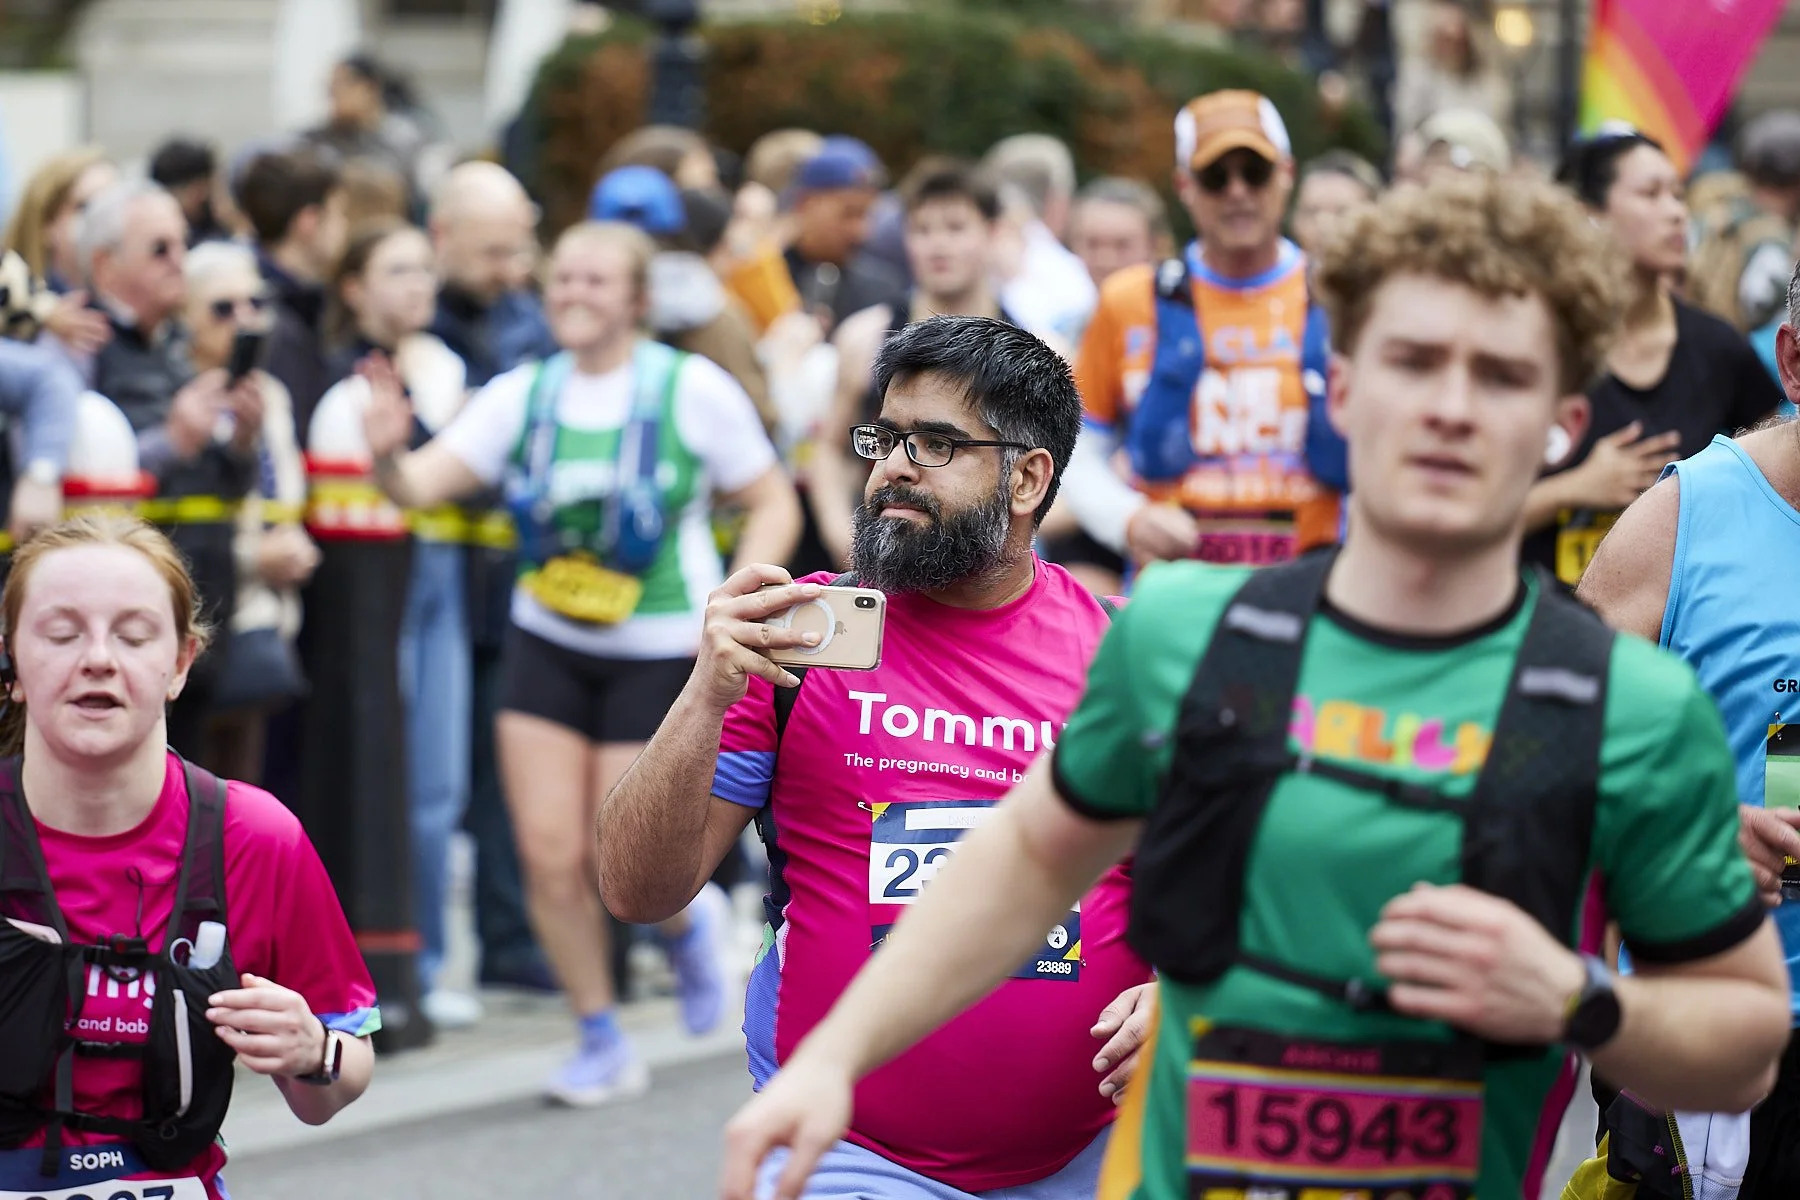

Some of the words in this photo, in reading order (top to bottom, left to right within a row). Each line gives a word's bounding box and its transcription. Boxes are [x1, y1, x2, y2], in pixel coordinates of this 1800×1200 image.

[1773, 678, 1800, 693] GR
[844, 753, 873, 768] The
[879, 757, 970, 778] pregnancy
[974, 767, 1007, 782] and
[1054, 936, 1060, 944] 4
[1037, 961, 1071, 974] 23889
[78, 1017, 112, 1032] and
[1207, 1087, 1459, 1163] 15943
[69, 1150, 125, 1171] SOPH
